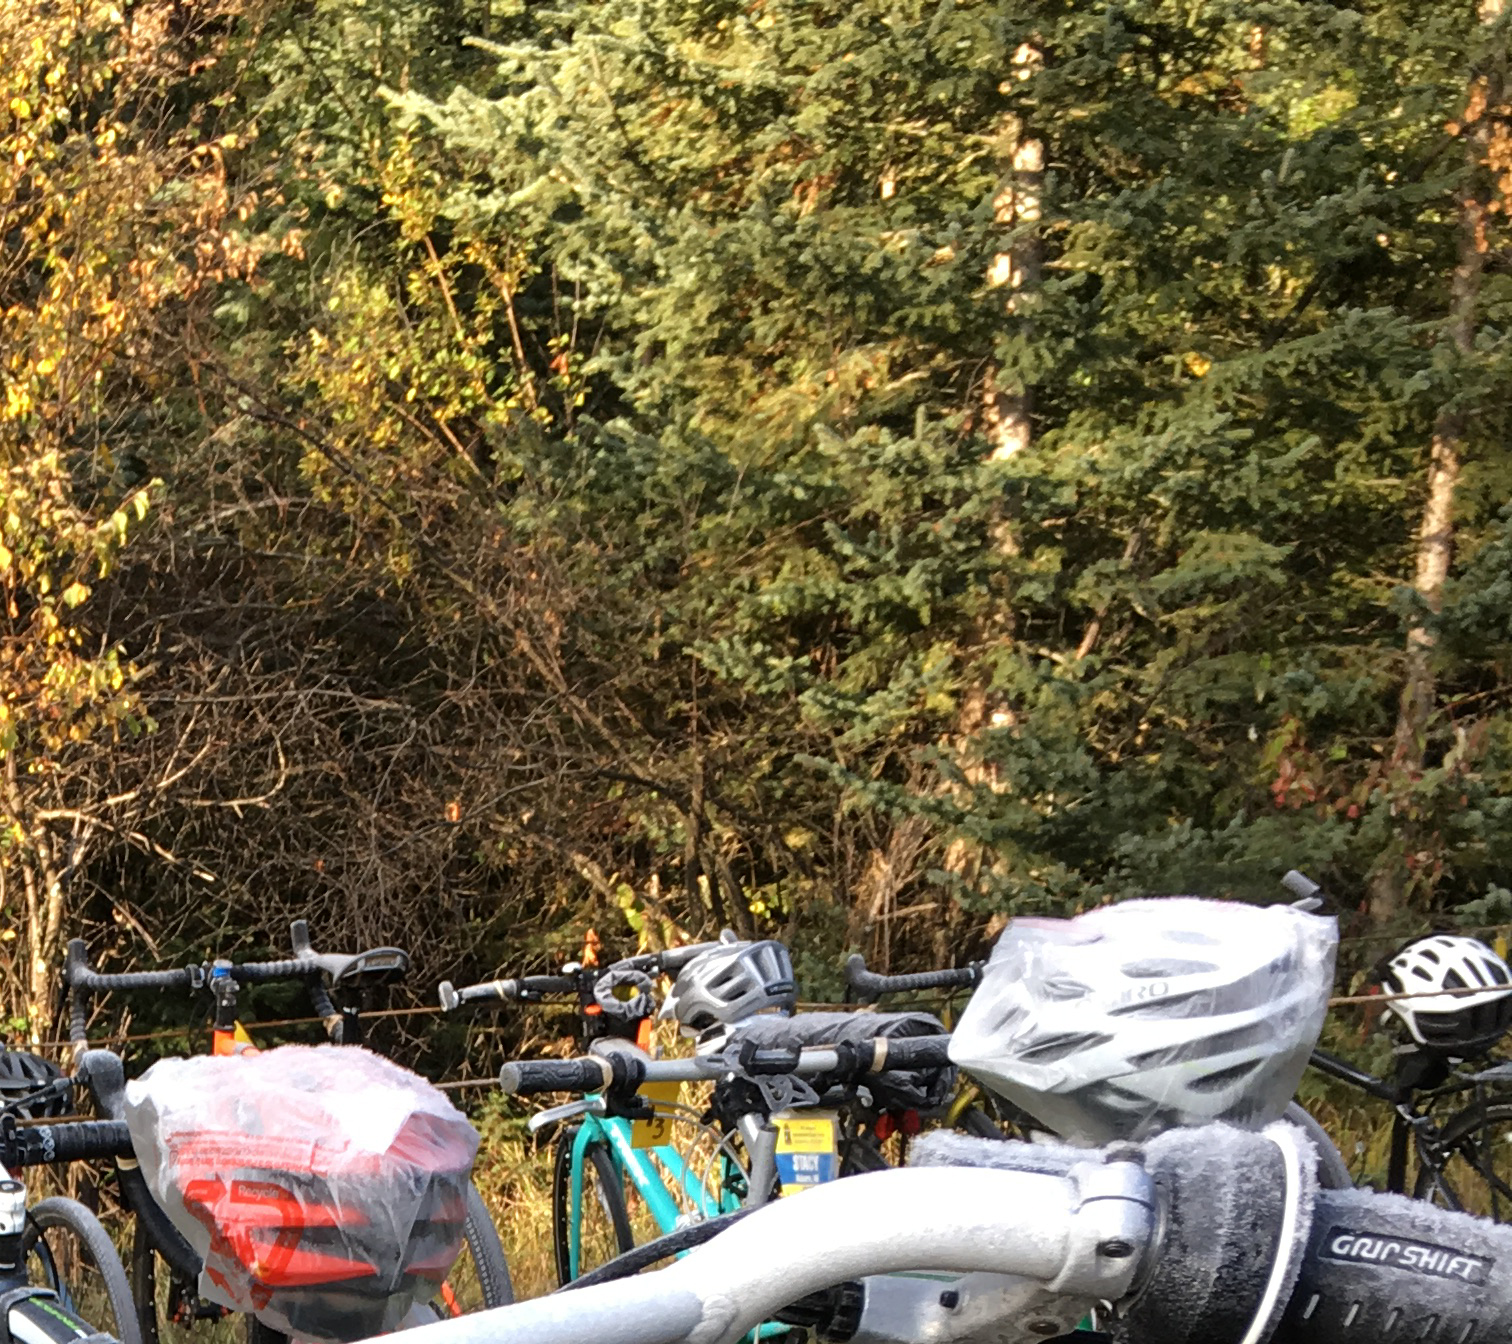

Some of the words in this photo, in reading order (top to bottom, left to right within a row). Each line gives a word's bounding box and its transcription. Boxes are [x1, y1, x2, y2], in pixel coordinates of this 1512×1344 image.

[238, 1184, 279, 1200] Recycle
[1331, 1235, 1400, 1261] GRIP
[1398, 1246, 1483, 1279] SHIFT
